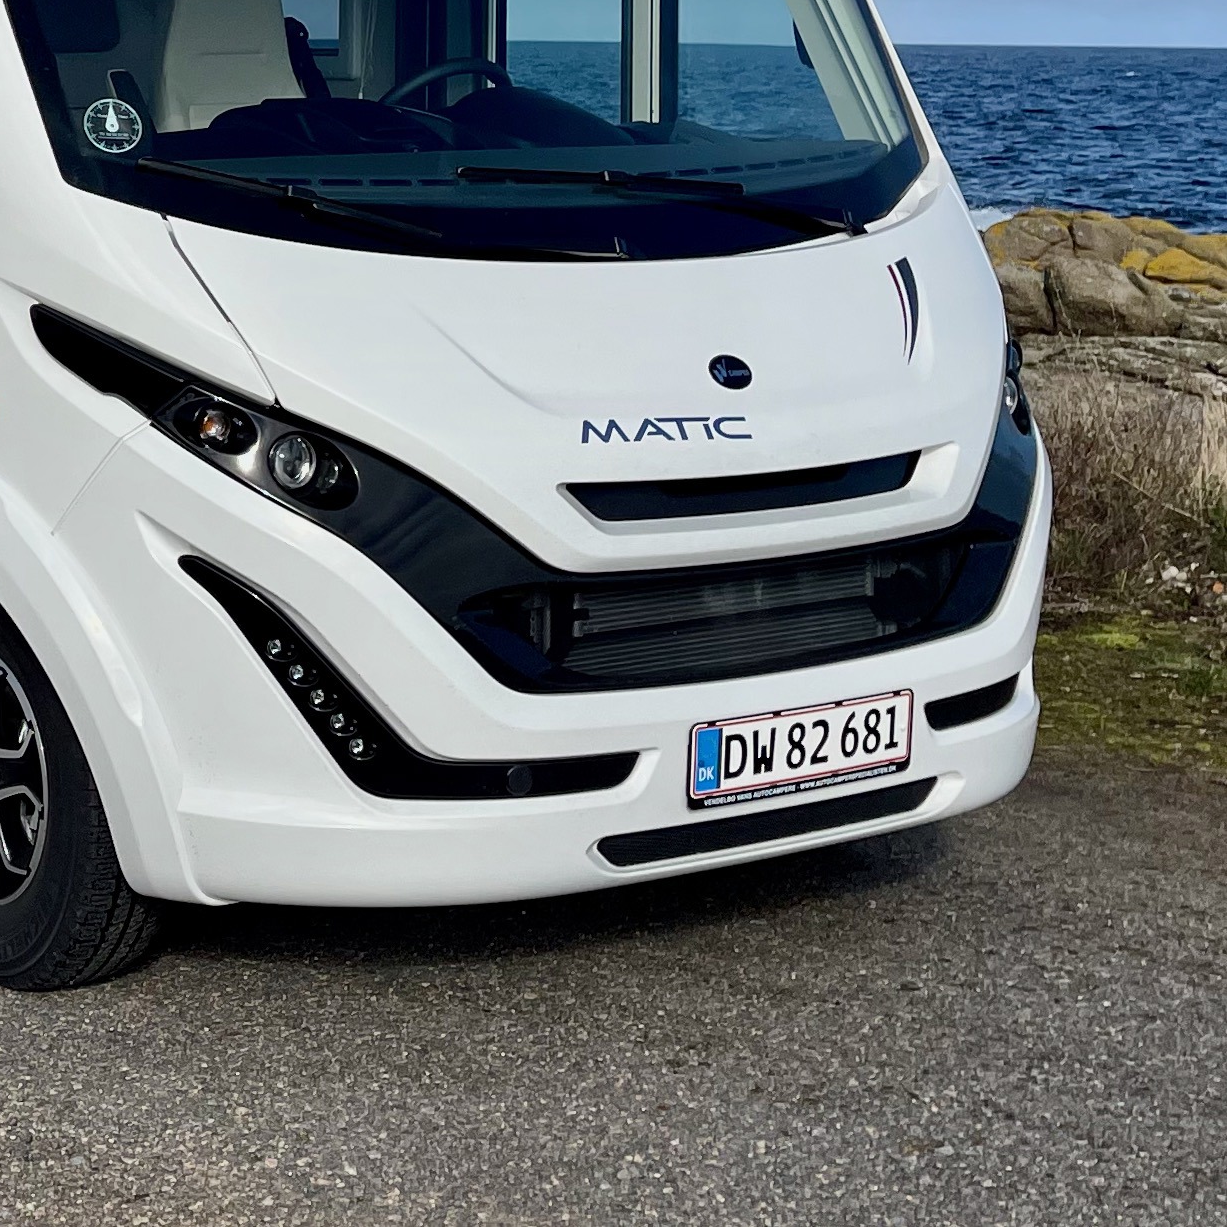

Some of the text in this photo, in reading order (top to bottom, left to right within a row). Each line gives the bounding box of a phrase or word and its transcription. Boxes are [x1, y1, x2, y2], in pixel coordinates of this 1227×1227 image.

[723, 705, 899, 780] DW 82 681
[698, 765, 715, 782] DK
